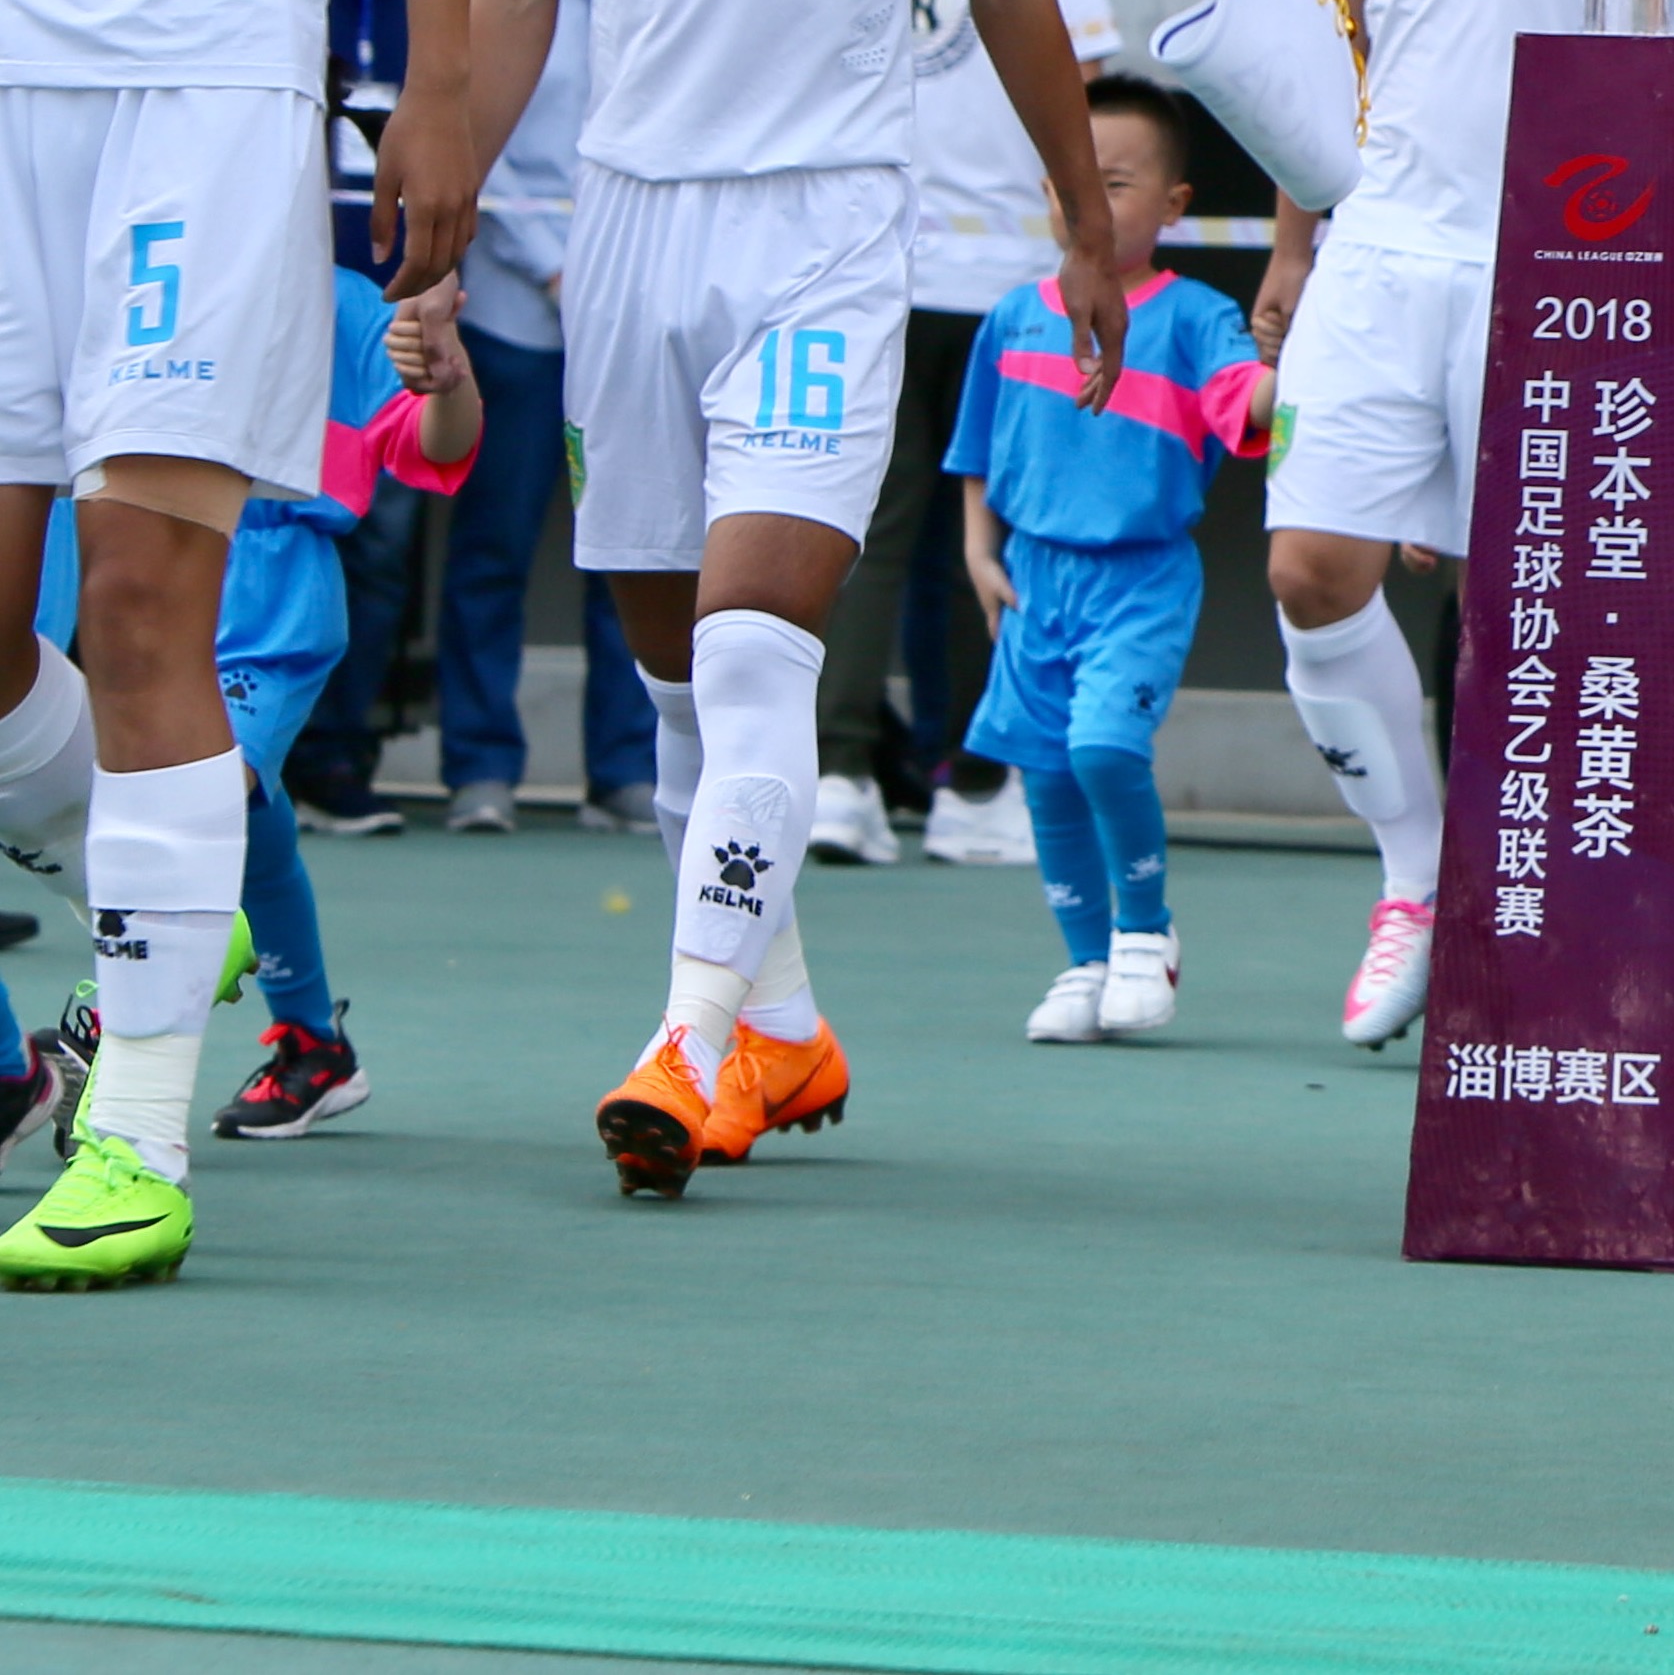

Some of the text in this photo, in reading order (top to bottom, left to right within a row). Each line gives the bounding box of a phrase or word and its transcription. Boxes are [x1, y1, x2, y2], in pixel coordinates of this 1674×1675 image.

[1534, 249, 1574, 261] CHINA
[1577, 251, 1623, 262] LEAGUE
[127, 221, 185, 347] 5
[1533, 297, 1652, 342] 2018
[109, 359, 216, 385] KELME
[756, 329, 846, 431] 16
[744, 429, 842, 456] KELME
[1495, 369, 1571, 938] 中国足球协会乙级联赛
[698, 884, 764, 918] KELME
[1446, 1043, 1662, 1106] 淄博赛区
